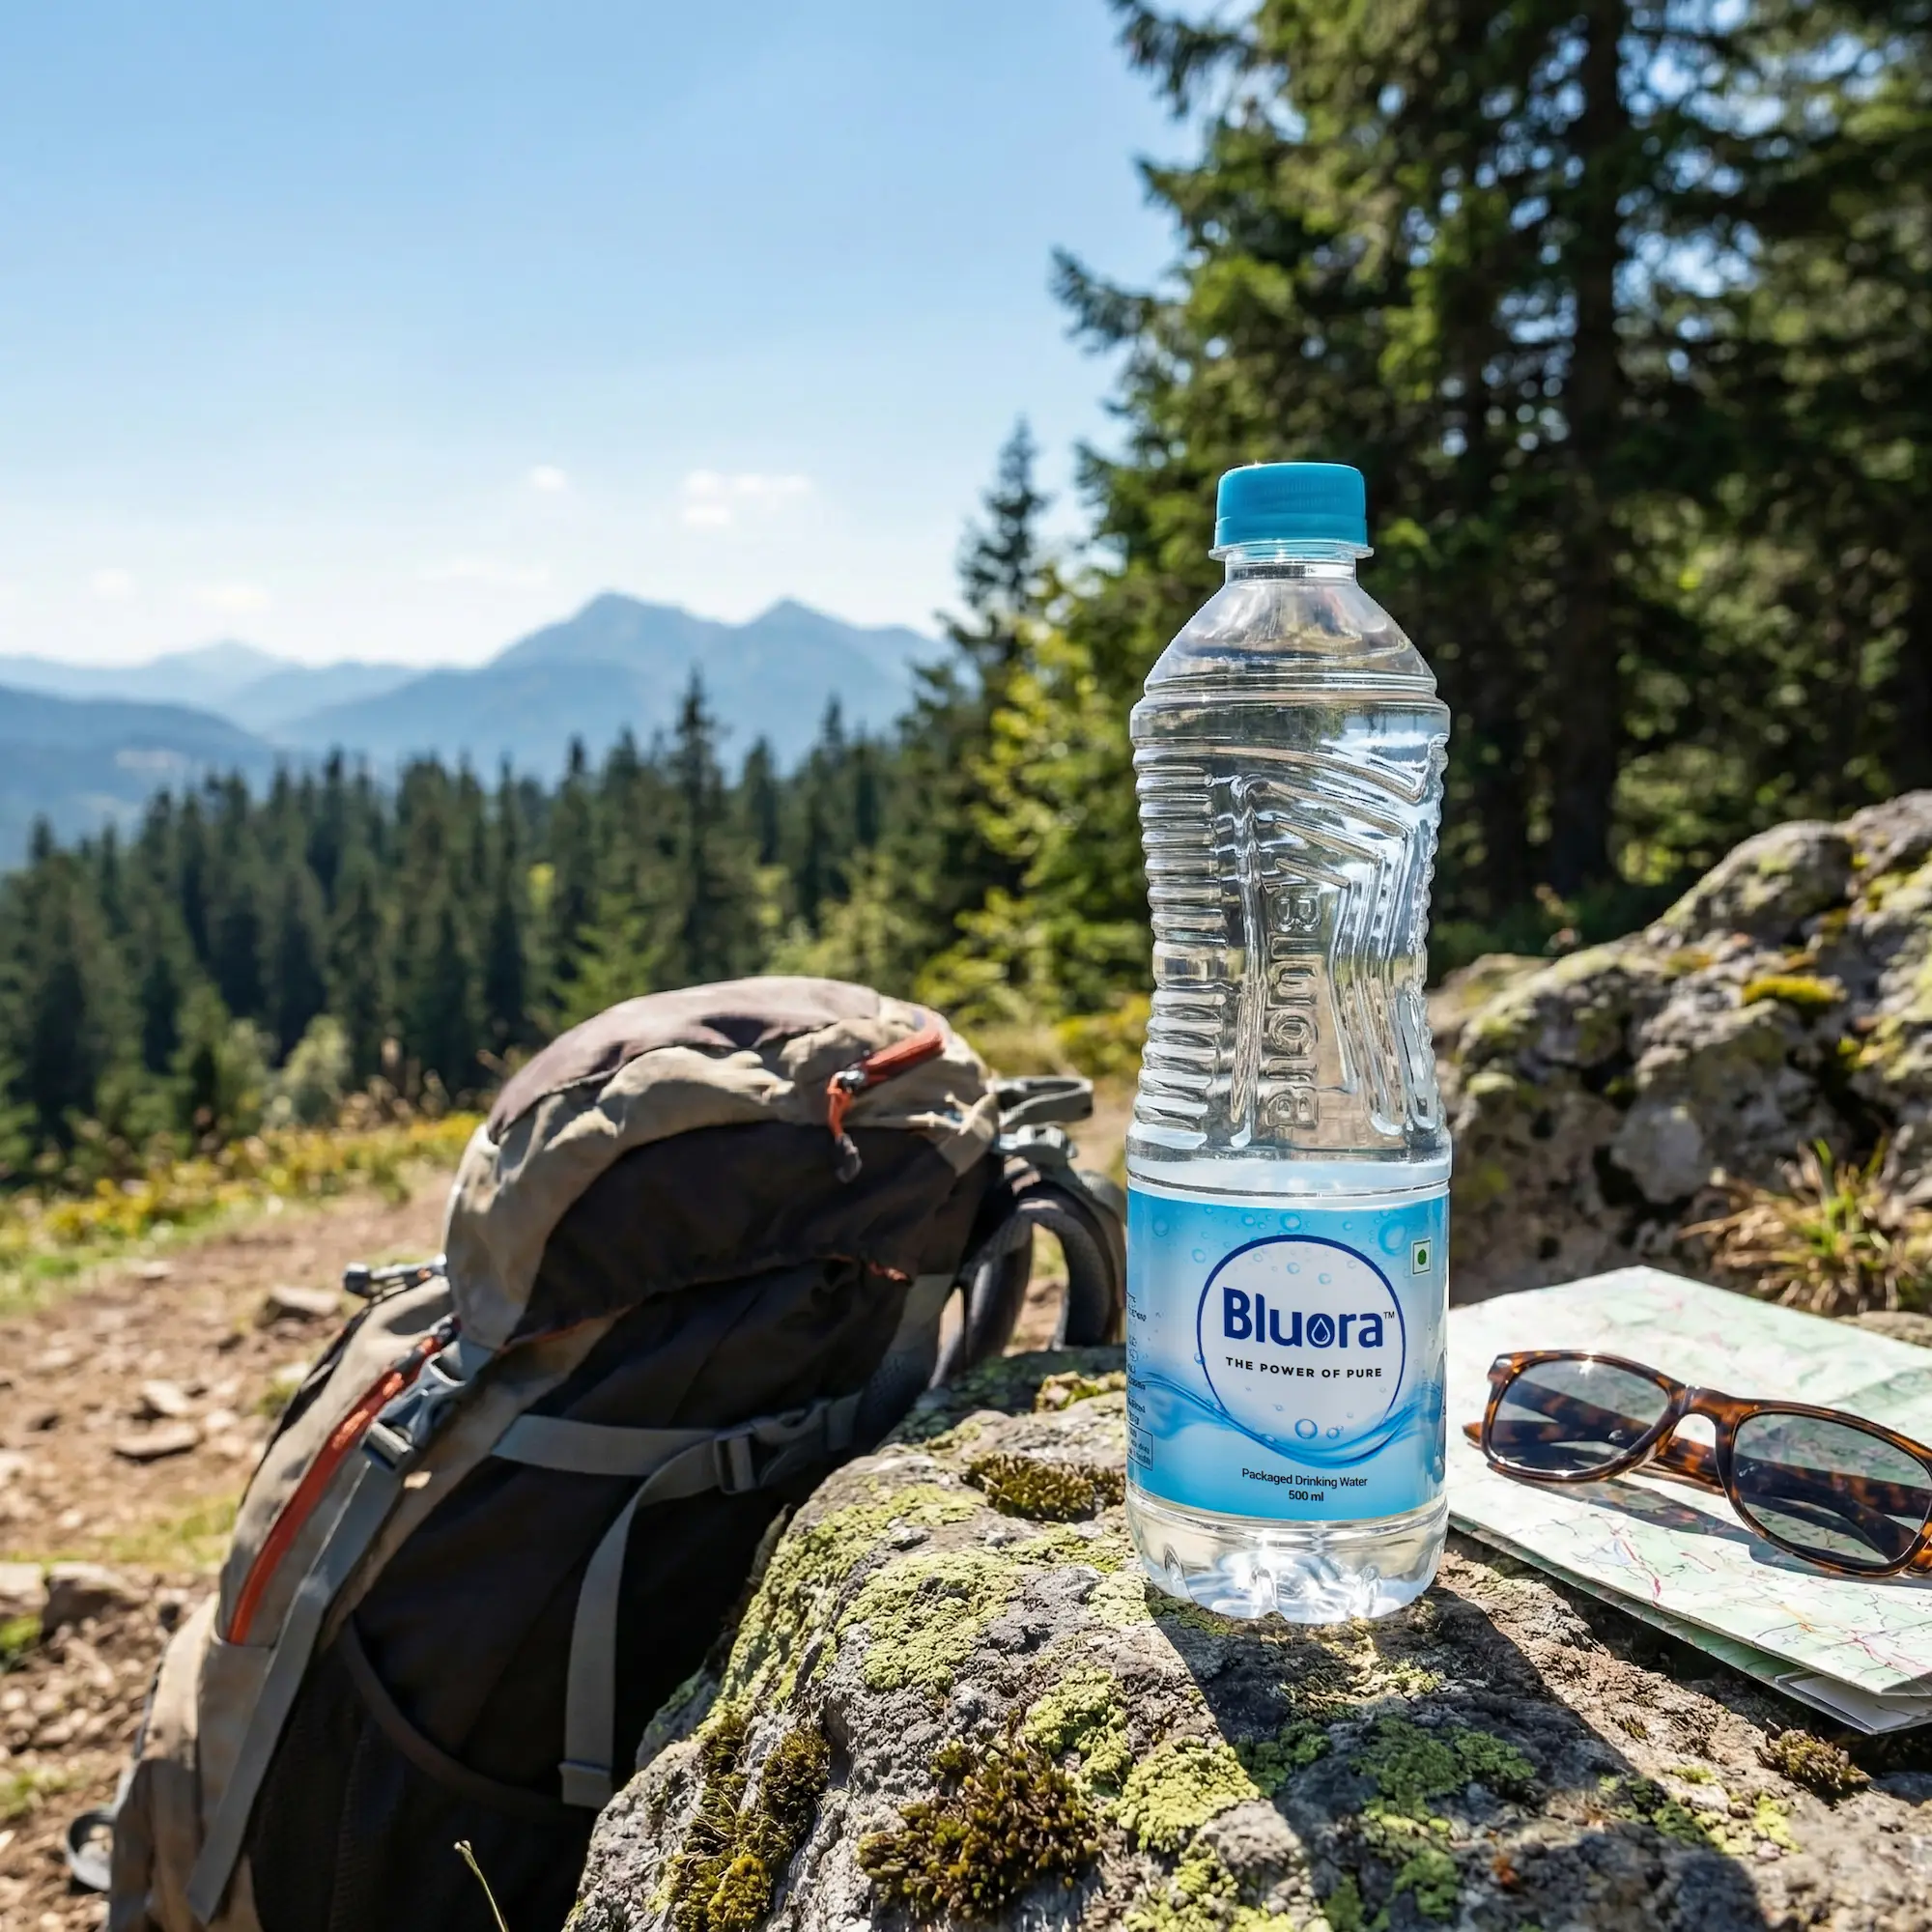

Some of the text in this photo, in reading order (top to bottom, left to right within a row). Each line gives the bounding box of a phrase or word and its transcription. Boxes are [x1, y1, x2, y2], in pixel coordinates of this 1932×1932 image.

[1223, 1287, 1383, 1349] Bluora
[1226, 1356, 1382, 1378] THE POWER OF PURE
[1242, 1467, 1368, 1489] Packaged Drinking Water
[1289, 1490, 1324, 1501] 500 ml
